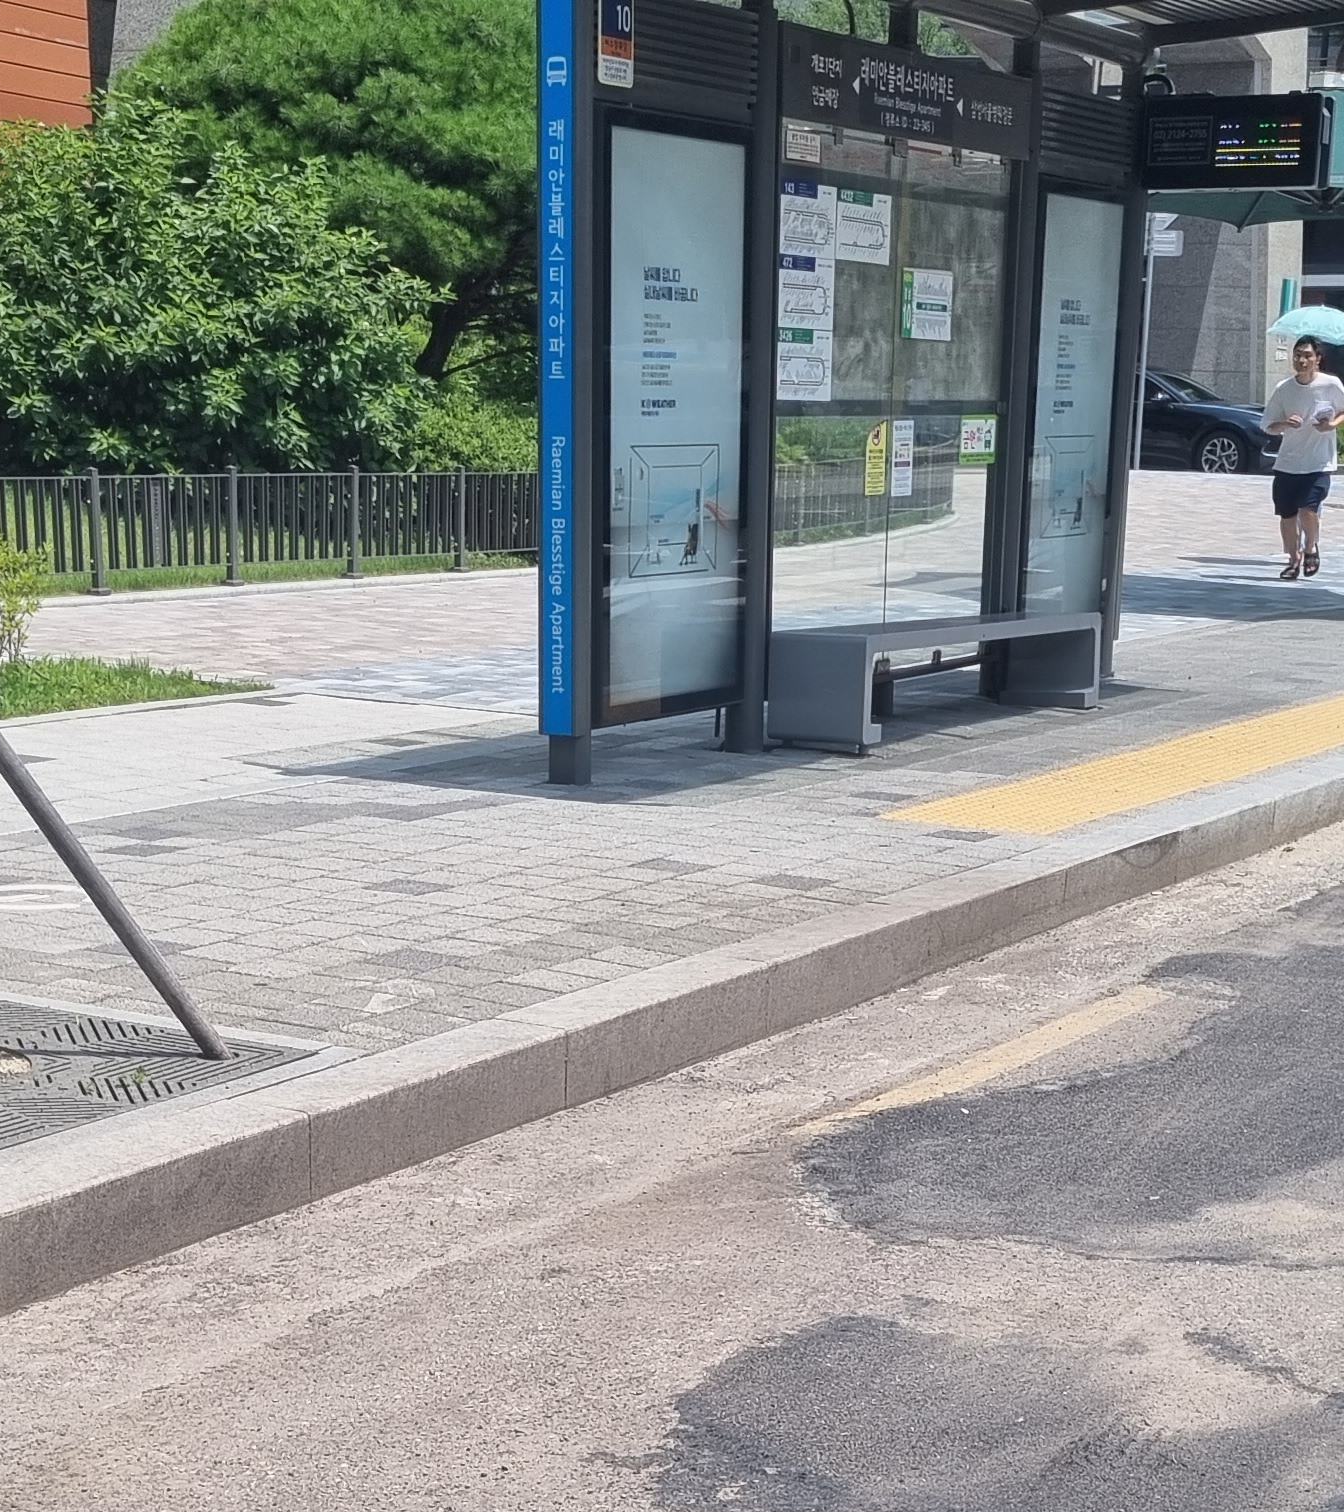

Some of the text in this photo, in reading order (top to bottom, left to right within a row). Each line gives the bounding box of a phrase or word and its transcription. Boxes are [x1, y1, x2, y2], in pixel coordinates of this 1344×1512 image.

[616, 4, 631, 33] 10
[811, 53, 842, 78] 개포1단지
[860, 57, 955, 103] 래미안블레스티지아파트
[784, 182, 795, 194] 143
[548, 119, 565, 380] 래미안블레스티지아파트
[549, 436, 566, 694] Raemian Blesstige Apartment
